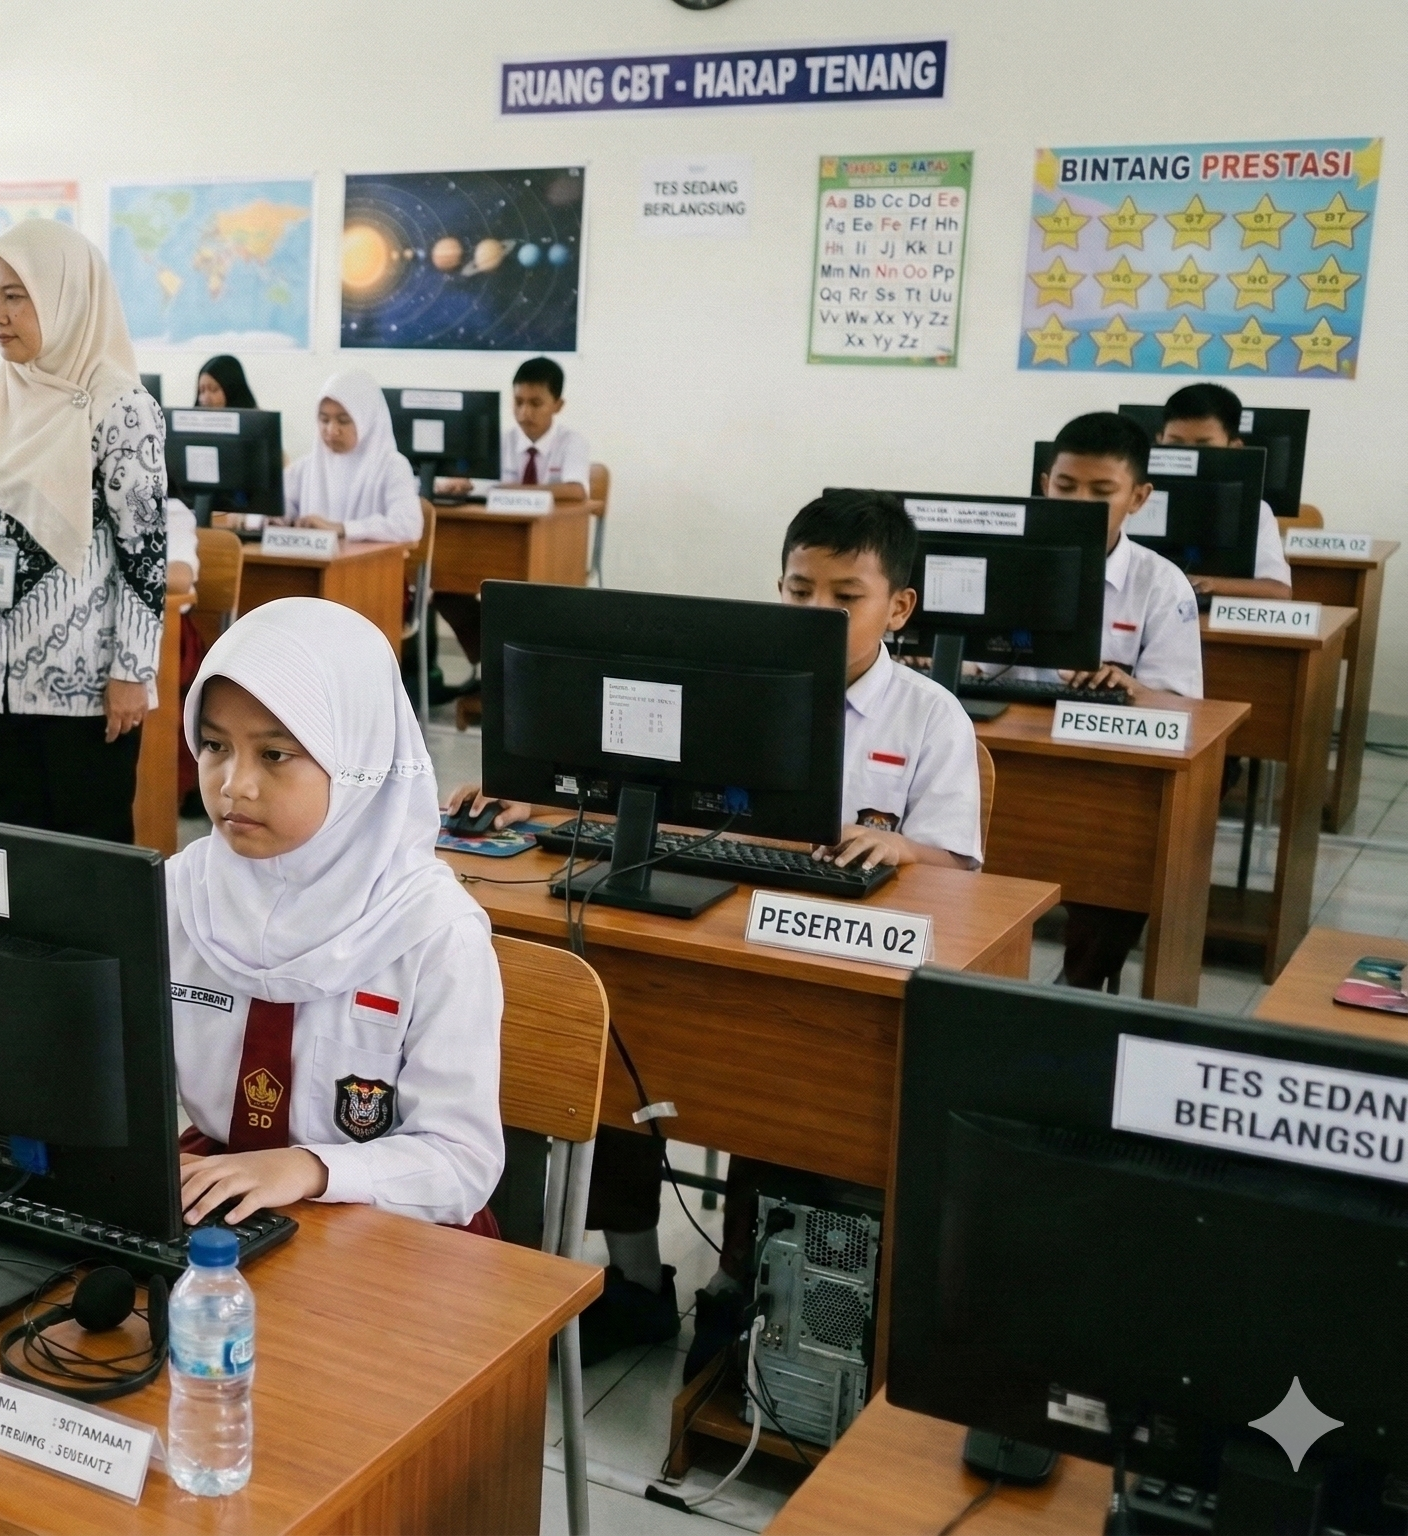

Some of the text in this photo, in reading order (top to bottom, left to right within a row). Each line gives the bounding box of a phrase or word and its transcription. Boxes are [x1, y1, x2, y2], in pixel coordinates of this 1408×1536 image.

[506, 66, 603, 106] RUANG
[611, 64, 670, 102] CBT
[694, 58, 797, 98] HARAP
[805, 50, 936, 94] TENANG
[1061, 151, 1352, 182] BINTANG PRESTASI
[654, 181, 738, 195] TES SEDANG
[826, 192, 959, 209] Aa Bb Cc Dd Ee
[644, 202, 746, 217] BERLANGSUNG
[853, 218, 873, 231] Ee
[881, 218, 901, 231] Fe
[910, 217, 927, 231] Ff
[936, 217, 958, 231] Hh
[906, 241, 927, 254] Kk
[821, 264, 954, 281] Mm Nn Nn Oo Pp
[820, 288, 952, 303] Qq Rr Ss Tt Uu
[820, 310, 839, 323] Vv
[873, 311, 894, 324] Xx
[903, 311, 923, 328] Yy
[929, 312, 948, 325] Zz
[845, 334, 919, 351] Xx Yy Zz
[1349, 539, 1367, 551] 02
[1216, 606, 1311, 626] PESERTA 01
[1061, 712, 1179, 741] PESERTA 03
[758, 906, 916, 954] PESERTA 02
[1197, 1062, 1264, 1098] TES
[248, 1112, 272, 1129] 3D
